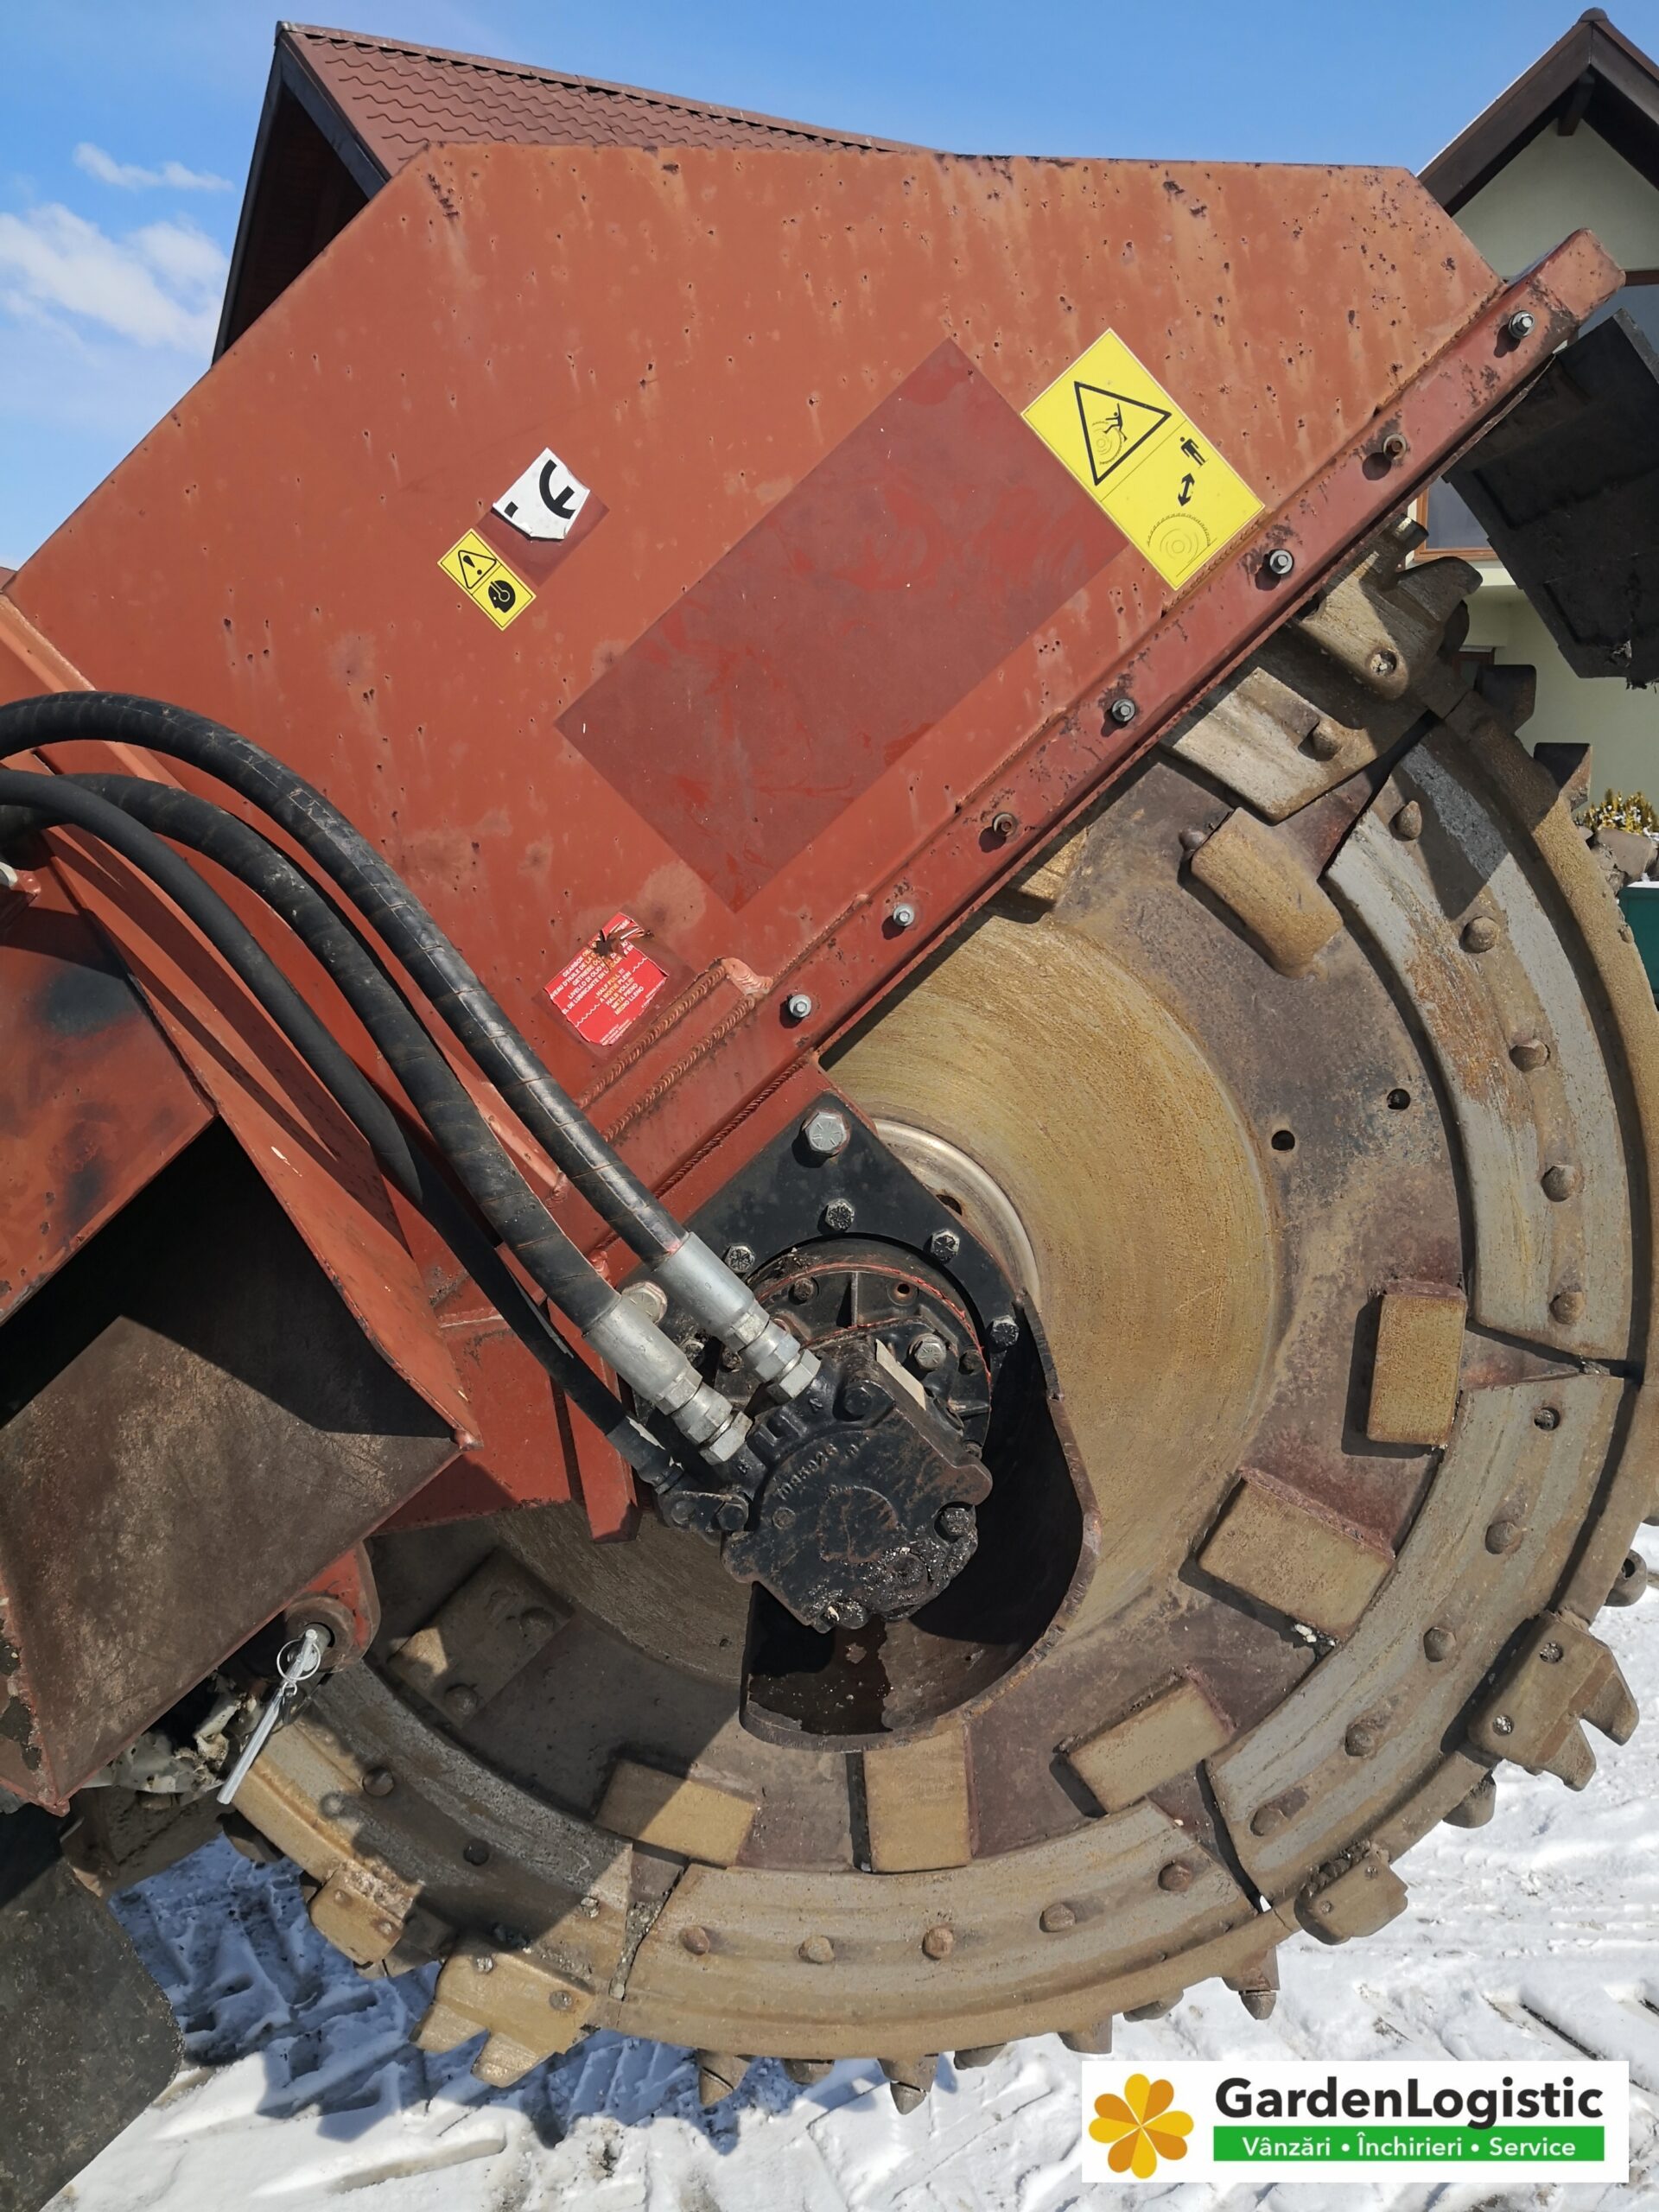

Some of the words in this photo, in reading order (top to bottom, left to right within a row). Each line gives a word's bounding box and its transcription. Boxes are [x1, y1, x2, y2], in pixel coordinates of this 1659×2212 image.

[562, 956, 583, 976] GEARBOX
[585, 955, 594, 963] LA
[596, 983, 608, 995] HALF
[607, 973, 620, 985] FULL
[618, 970, 631, 984] PLEIN
[614, 1000, 630, 1014] MEDIO
[628, 986, 644, 1001] LLENO
